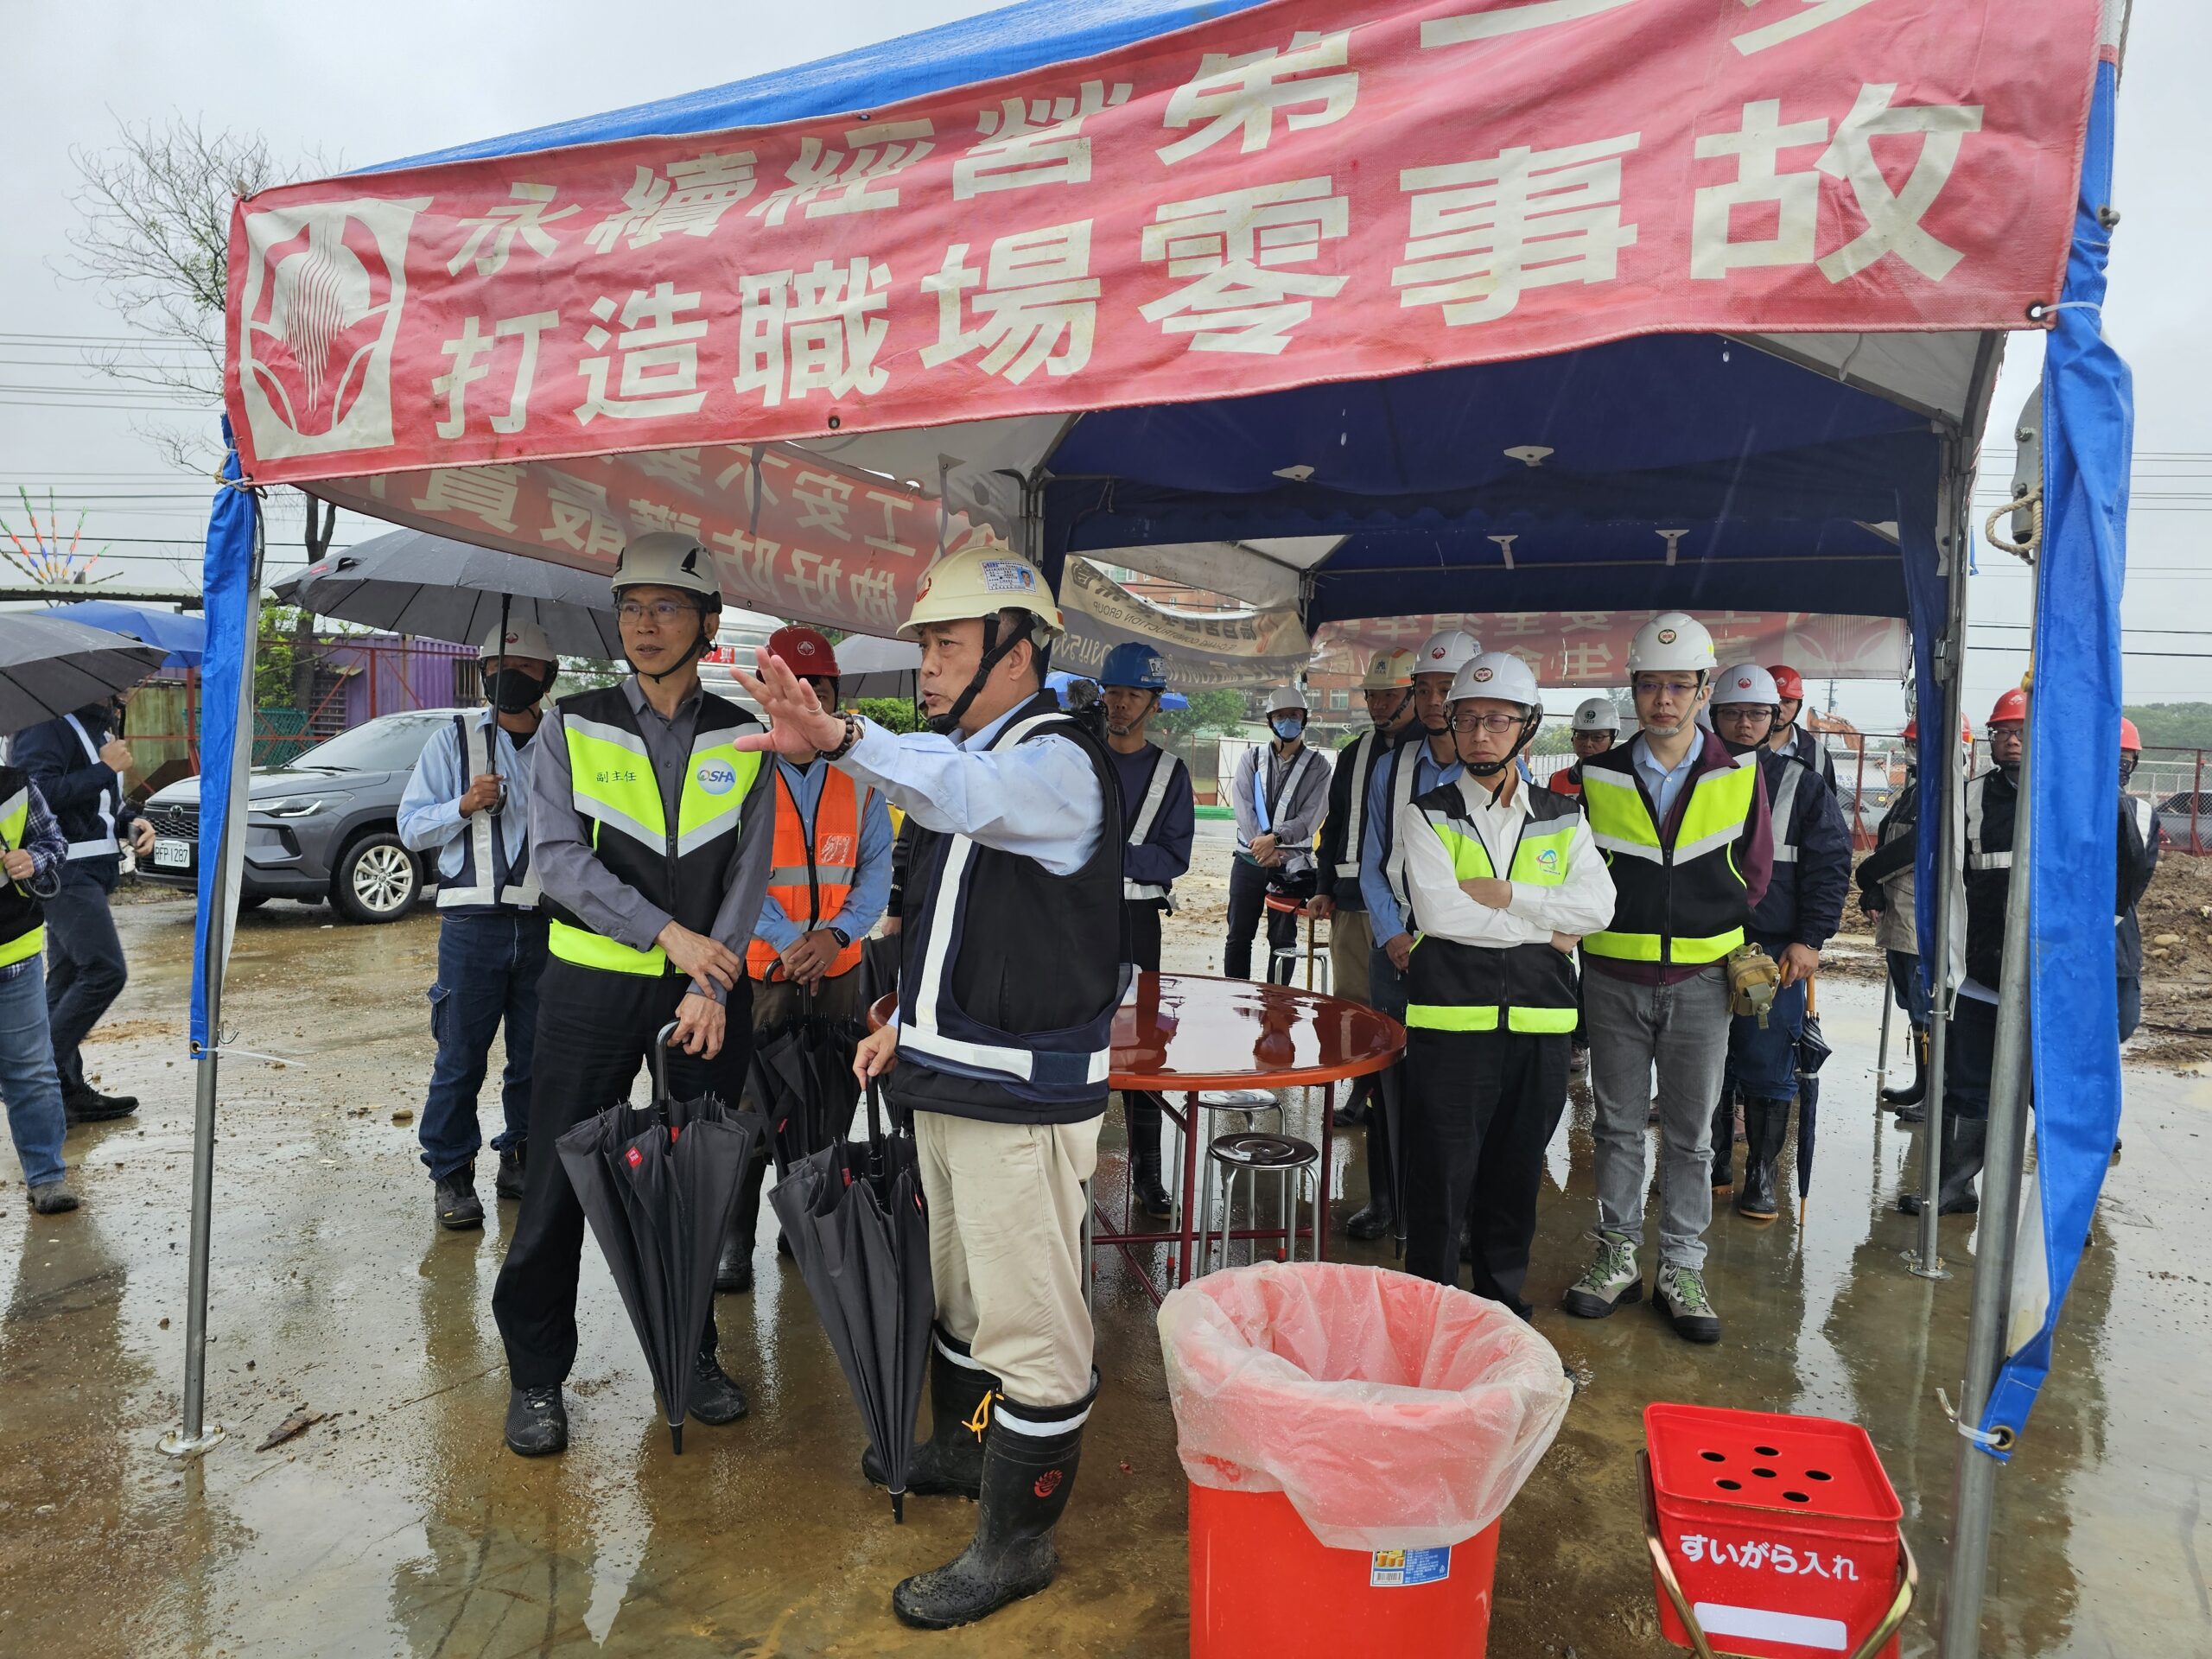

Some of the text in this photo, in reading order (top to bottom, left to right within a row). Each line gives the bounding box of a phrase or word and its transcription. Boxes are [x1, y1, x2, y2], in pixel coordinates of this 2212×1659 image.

[447, 0, 1873, 276] 永續經營第一
[430, 82, 1985, 438] 打造職場零事故
[596, 770, 637, 783] 副主任
[696, 769, 735, 783] OSHA
[155, 847, 188, 862] RFP-1287
[1680, 1534, 1859, 1581] すいがら入れ
